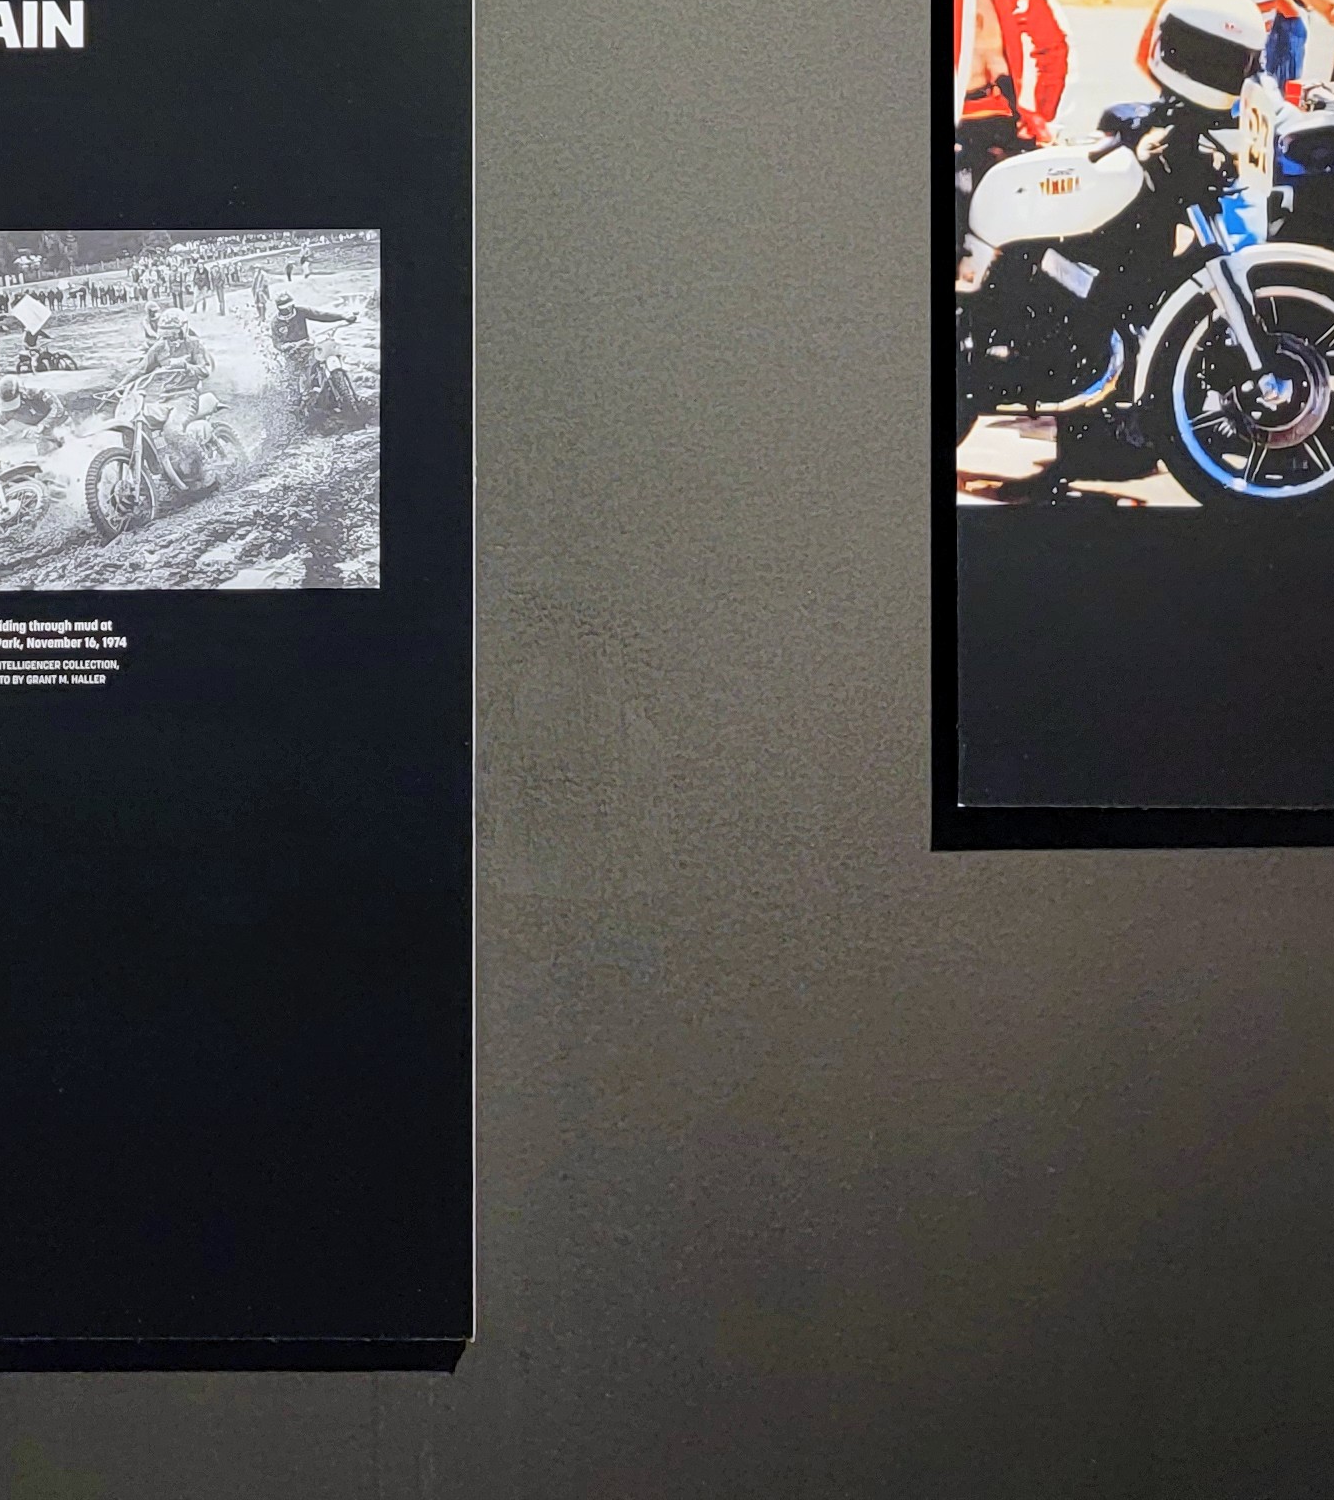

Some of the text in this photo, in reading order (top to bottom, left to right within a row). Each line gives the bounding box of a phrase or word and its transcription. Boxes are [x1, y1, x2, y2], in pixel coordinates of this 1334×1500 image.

[27, 618, 73, 634] through
[73, 618, 99, 631] mud
[99, 619, 113, 631] at
[25, 635, 83, 649] November
[83, 636, 100, 650] 16,
[101, 635, 128, 648] 1974
[61, 659, 120, 670] COLLECTION,
[11, 674, 25, 685] BY
[25, 673, 57, 685] GRANT
[58, 674, 69, 684] M.
[70, 673, 106, 684] HALLER
